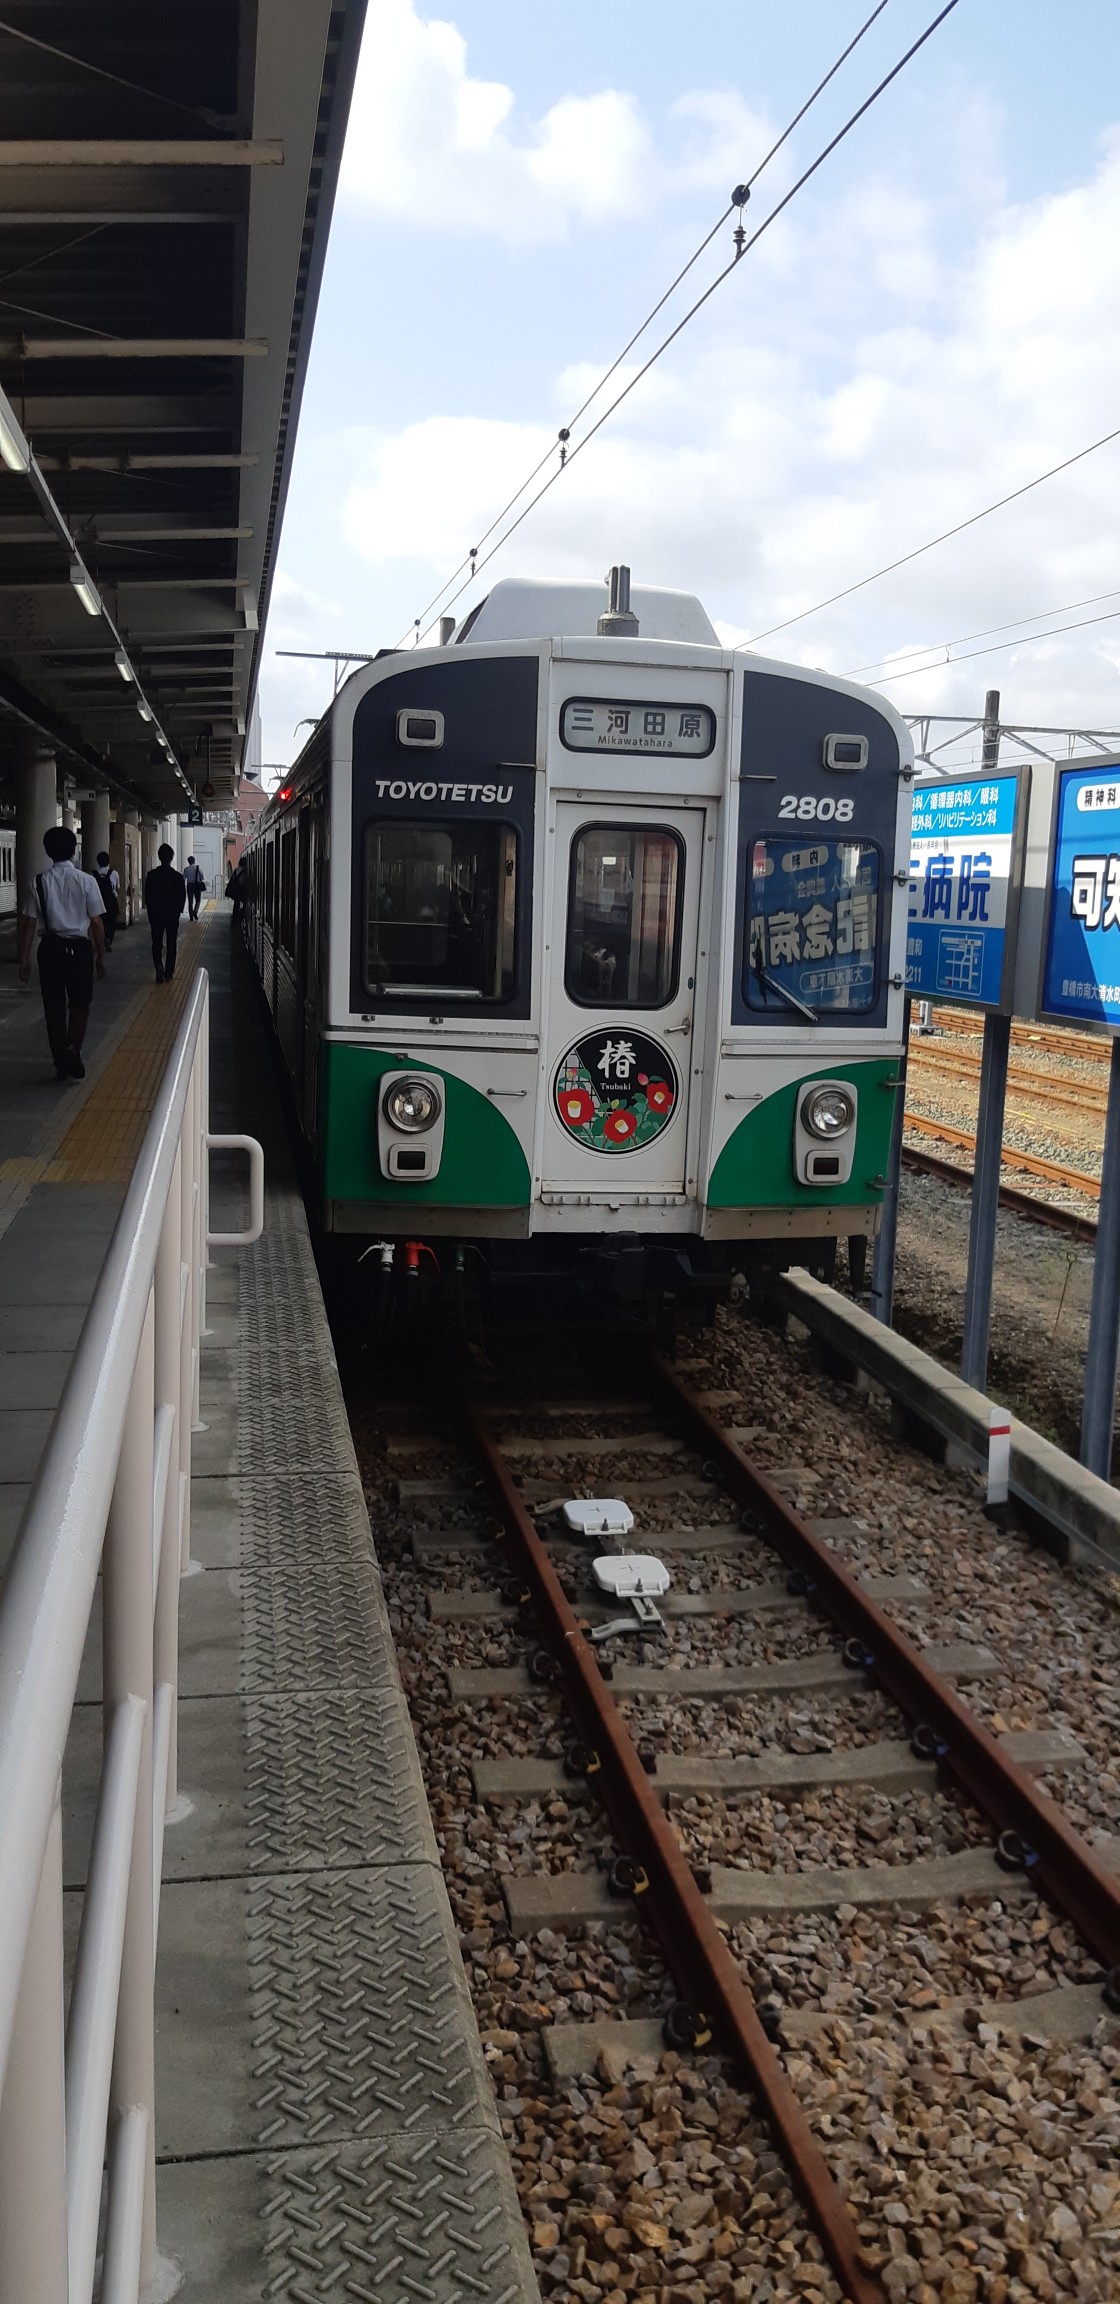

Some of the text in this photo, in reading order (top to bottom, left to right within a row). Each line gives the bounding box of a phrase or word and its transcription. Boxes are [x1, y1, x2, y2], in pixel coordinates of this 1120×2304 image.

[571, 708, 702, 738] 三河田原
[597, 735, 673, 748] Mikawatahara
[375, 780, 514, 804] TOYOTETSU
[1084, 787, 1117, 807] 精神科
[191, 810, 200, 822] 2
[777, 795, 855, 822] 2808
[597, 1040, 637, 1079] 椿
[600, 1082, 631, 1091] Tsubaki
